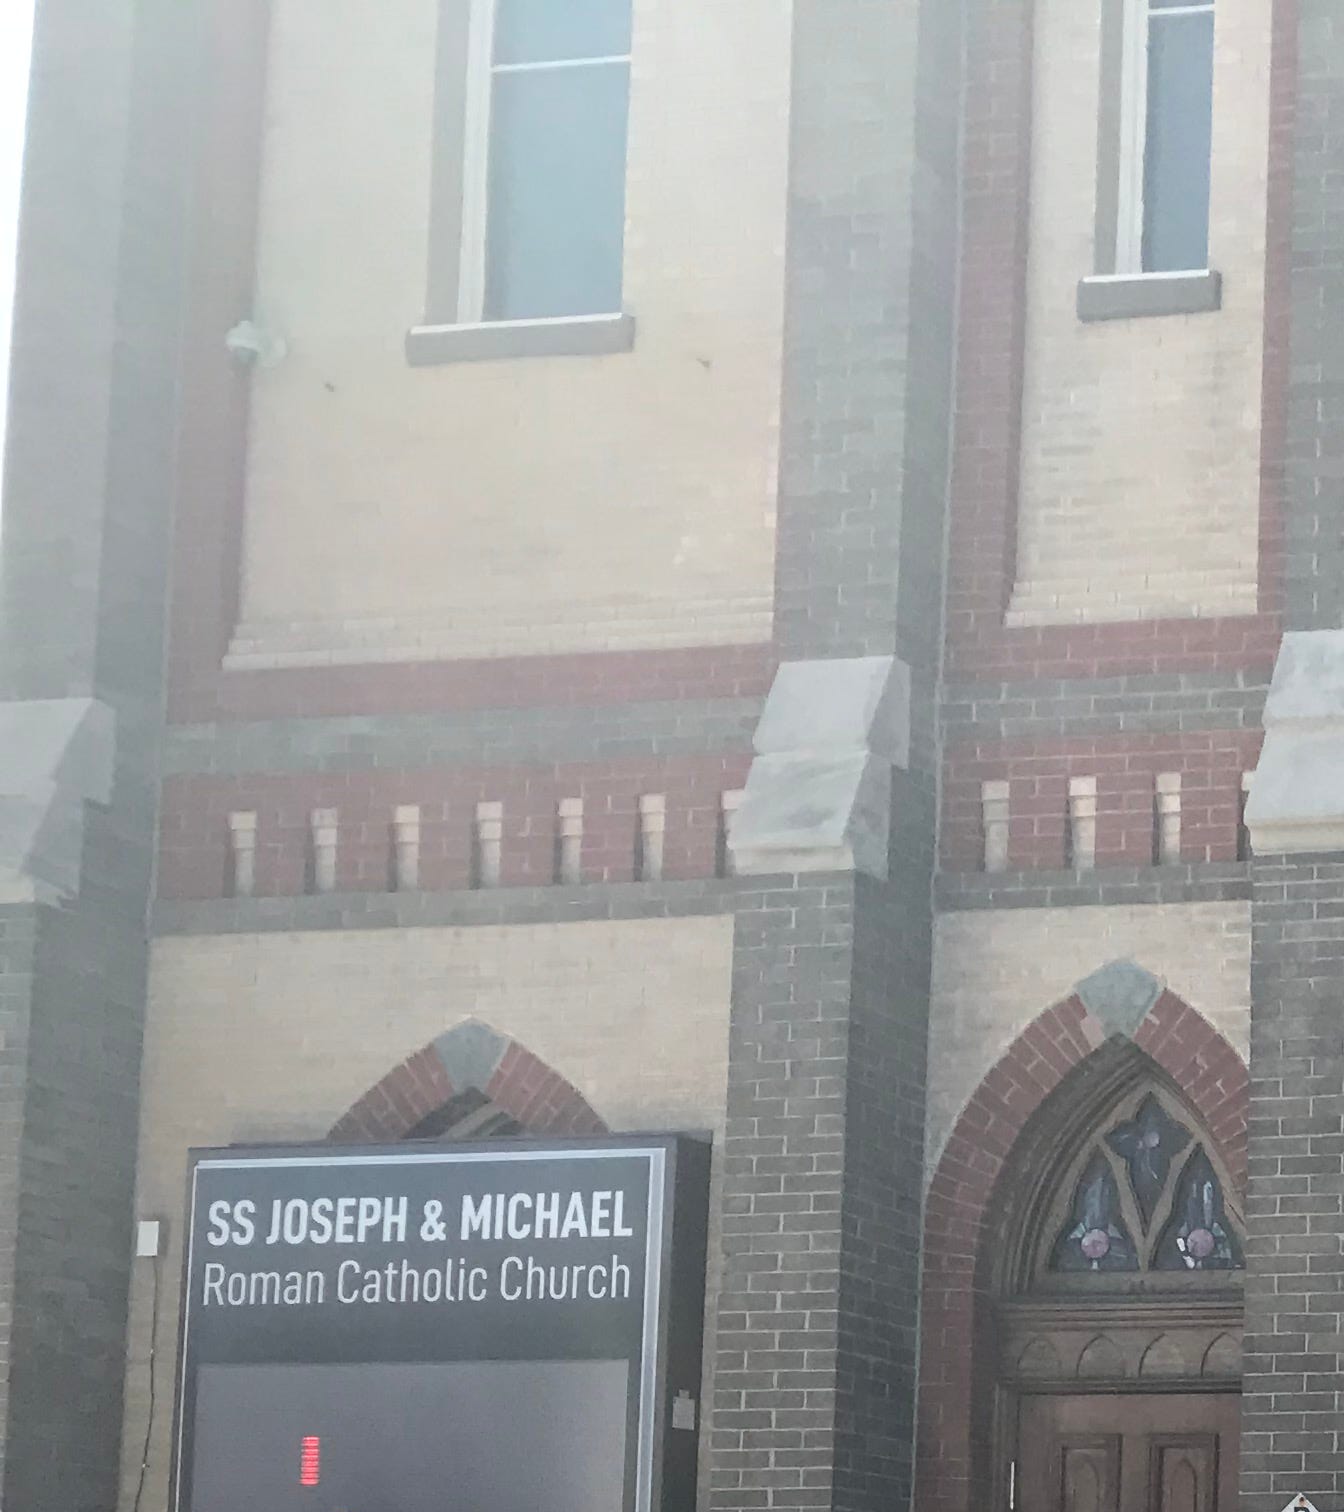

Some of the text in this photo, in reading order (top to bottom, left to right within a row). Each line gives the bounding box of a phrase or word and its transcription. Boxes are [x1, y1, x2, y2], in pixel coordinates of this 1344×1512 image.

[207, 1190, 633, 1246] SS JOSEPH & MICHAEL
[203, 1254, 629, 1306] Roman Catholic Church
